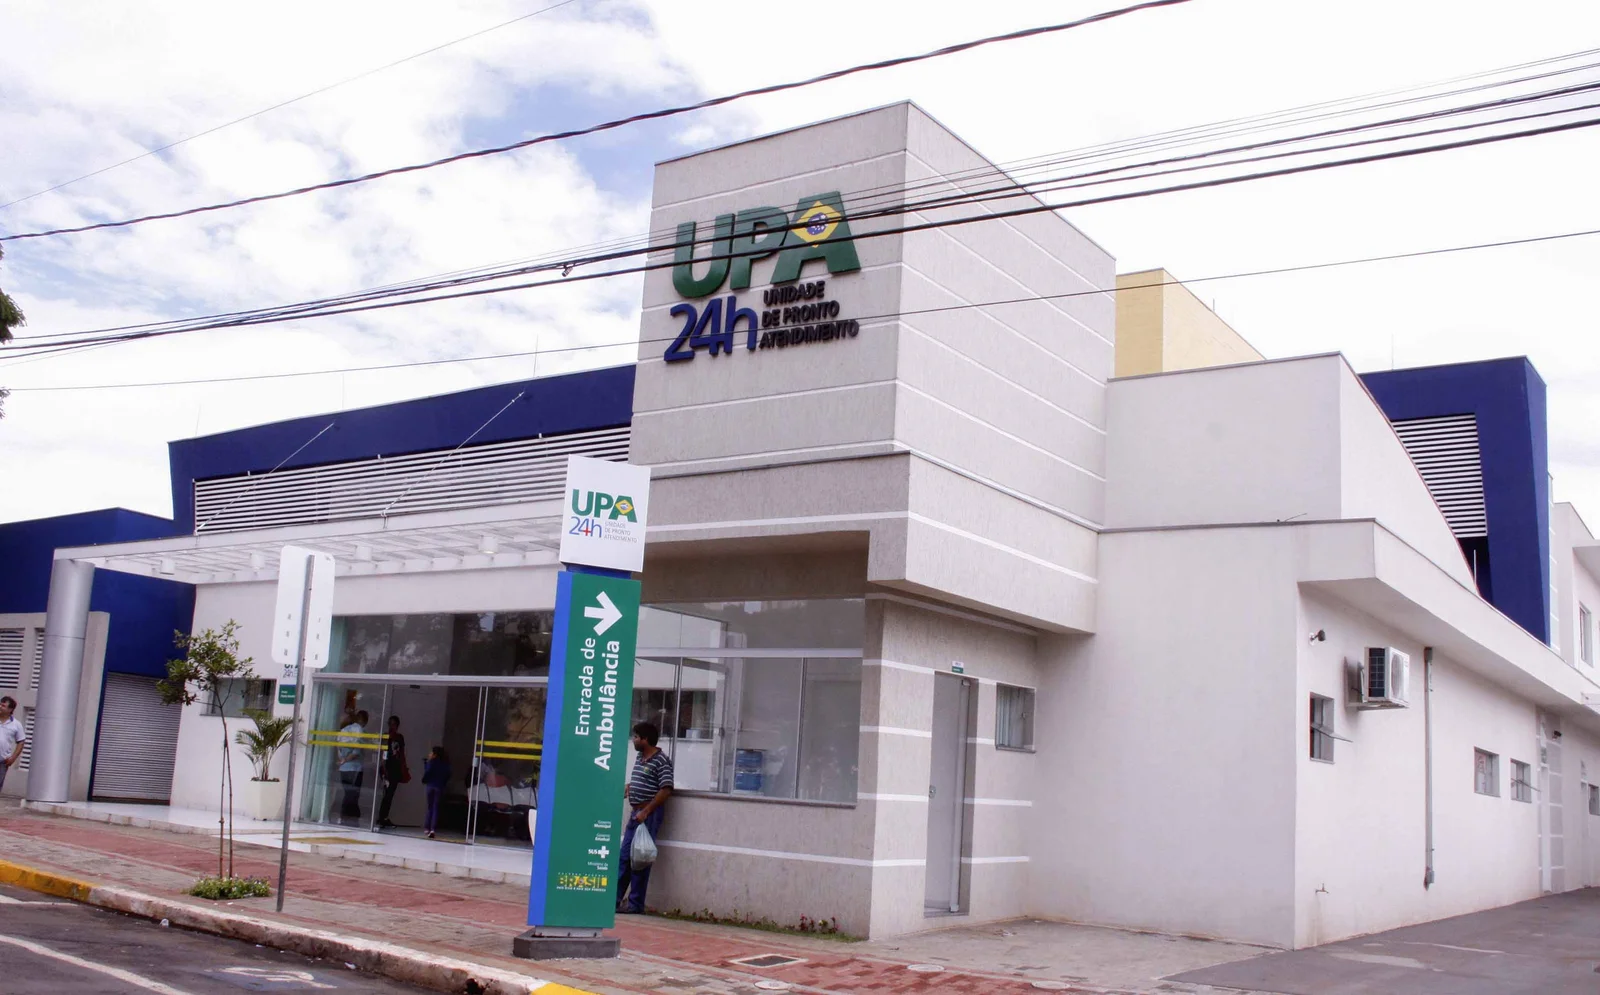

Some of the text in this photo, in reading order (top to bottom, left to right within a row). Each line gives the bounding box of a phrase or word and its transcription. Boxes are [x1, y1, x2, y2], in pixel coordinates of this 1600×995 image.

[672, 191, 861, 298] UPA
[763, 281, 826, 306] UNIDADE
[664, 295, 758, 362] 24h
[762, 300, 840, 328] DE PRONTO
[759, 319, 860, 350] ATENDIMENTO
[572, 489, 638, 522] UPA
[569, 516, 603, 538] 24h
[575, 637, 596, 736] Entrada de
[594, 640, 620, 771] Ambulância
[559, 875, 608, 889] BRASIL
